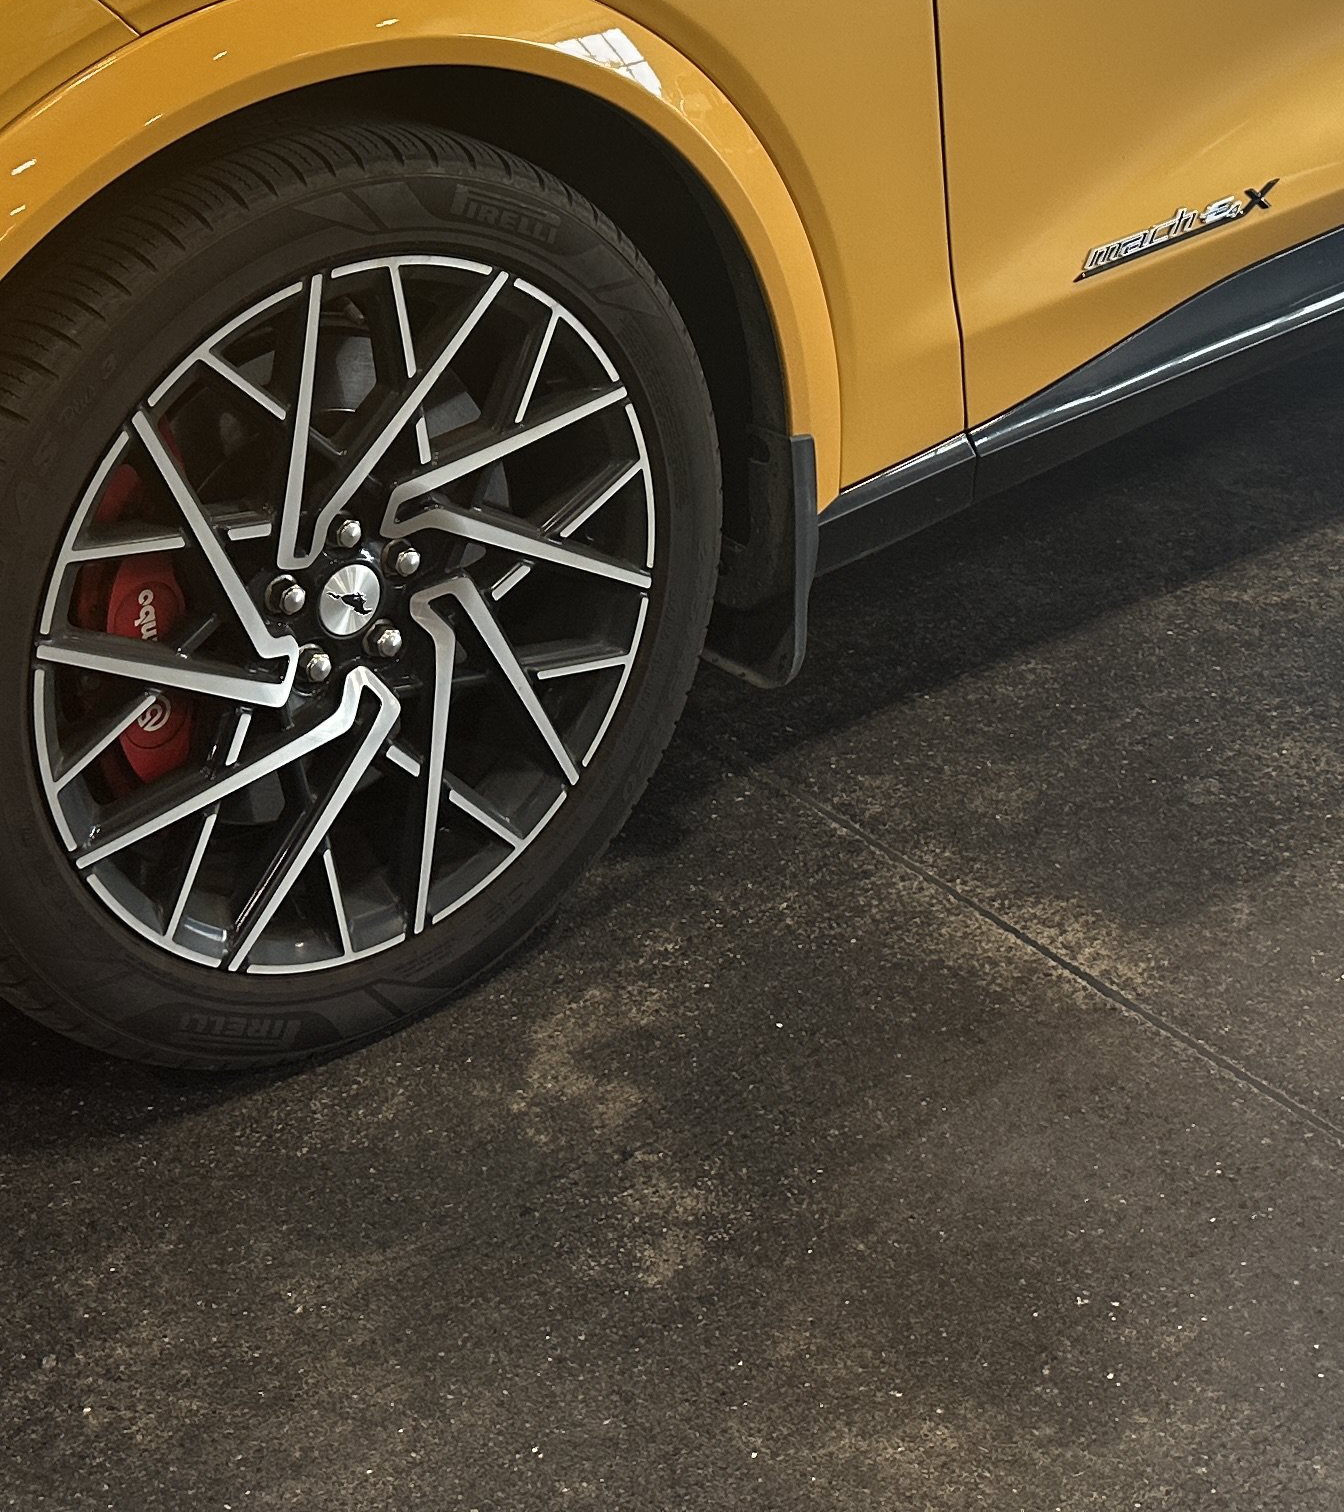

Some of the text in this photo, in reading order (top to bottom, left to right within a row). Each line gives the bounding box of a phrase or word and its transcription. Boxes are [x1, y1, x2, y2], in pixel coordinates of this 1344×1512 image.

[449, 183, 561, 245] PIRELLI
[134, 588, 158, 641] mbo
[176, 1011, 303, 1048] PIRELLI
